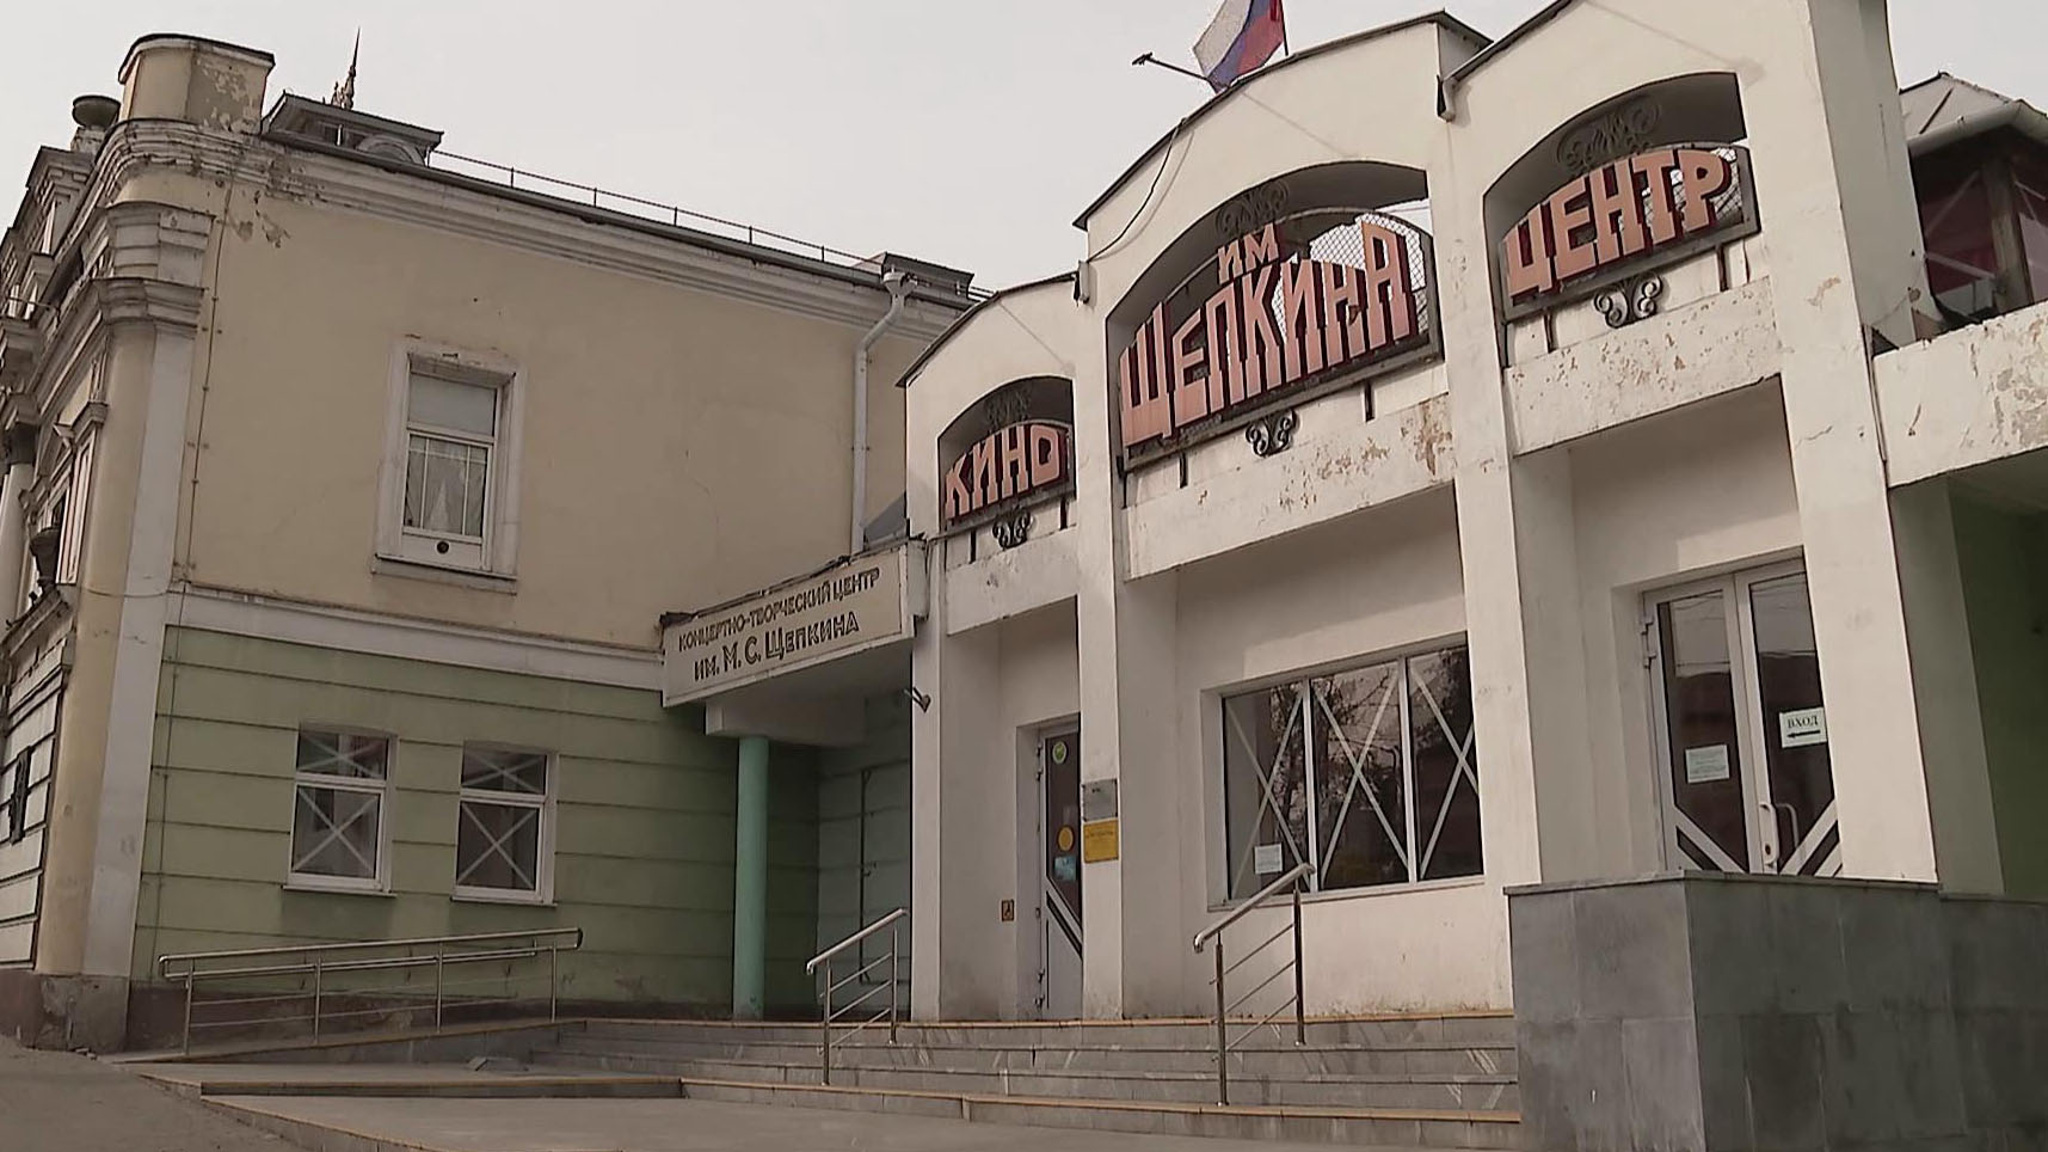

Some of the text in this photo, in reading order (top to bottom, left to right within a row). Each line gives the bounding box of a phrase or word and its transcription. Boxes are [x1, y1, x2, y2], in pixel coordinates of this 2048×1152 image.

[1217, 222, 1279, 285] ИМ
[1503, 149, 1724, 298] ЦЕНТР
[1119, 220, 1410, 447] ЩЕПКИНА
[944, 424, 1060, 520] КИНО
[678, 567, 880, 651] КОНЦЕРТНО-ТВОРЧЕСКИЙ ЦЕНТР
[1787, 714, 1819, 729] ВХОД
